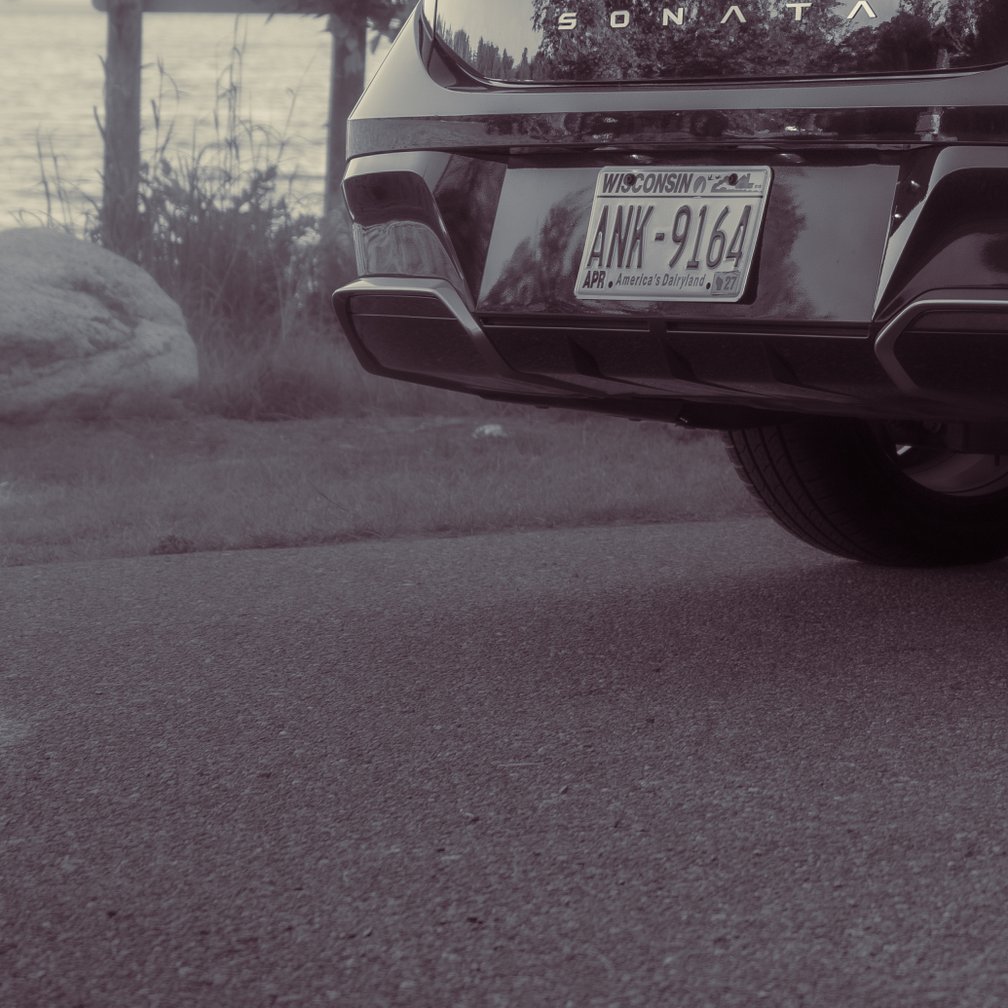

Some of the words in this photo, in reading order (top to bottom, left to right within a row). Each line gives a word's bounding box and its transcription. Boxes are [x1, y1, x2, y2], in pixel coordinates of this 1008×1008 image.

[557, 0, 877, 30] SONATA
[587, 205, 751, 270] ANK-9164
[582, 271, 606, 289] APR
[615, 273, 660, 287] America's
[662, 273, 705, 290] Dairyland
[723, 277, 737, 290] 27
